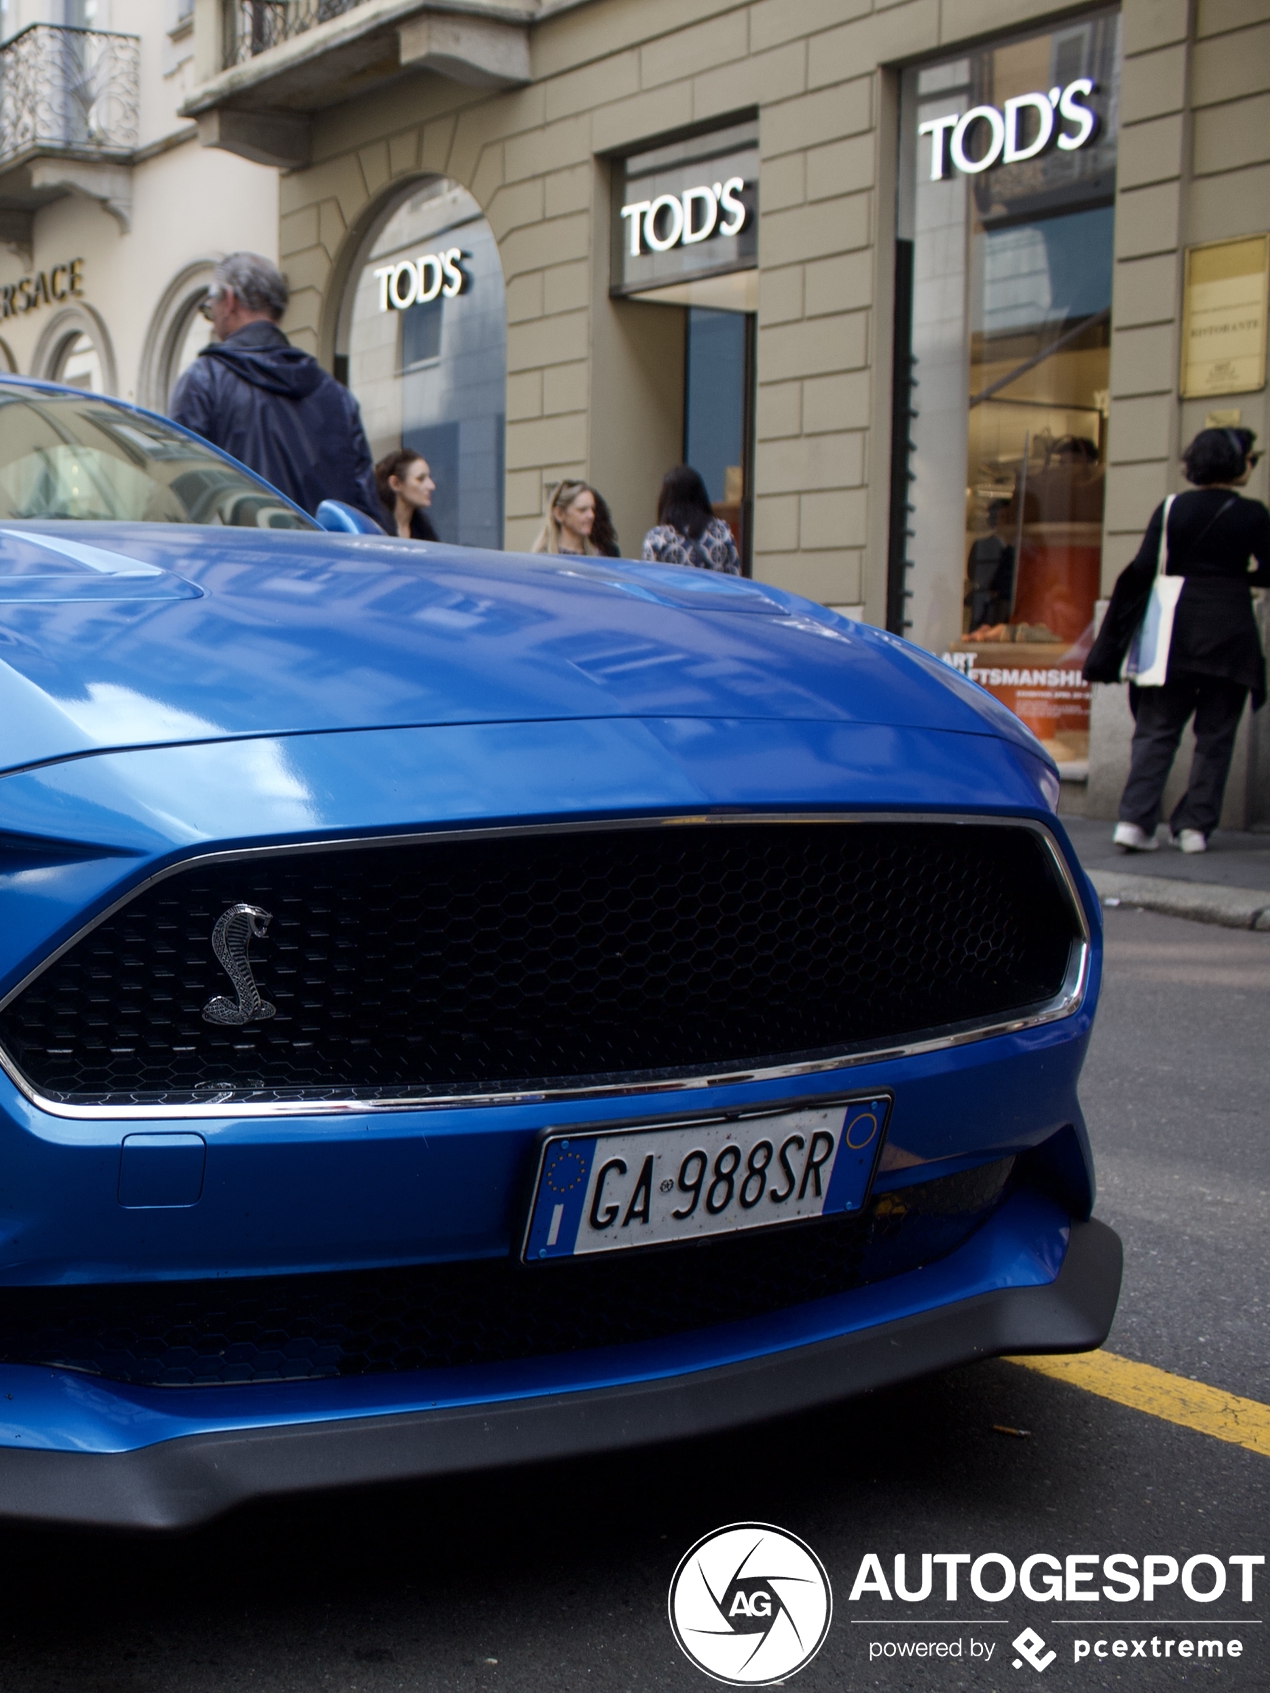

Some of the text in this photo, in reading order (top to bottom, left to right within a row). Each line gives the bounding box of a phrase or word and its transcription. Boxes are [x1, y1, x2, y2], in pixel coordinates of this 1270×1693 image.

[918, 77, 1096, 182] TOD'S
[620, 176, 746, 257] TOD'S
[373, 247, 463, 313] TOD'S
[960, 668, 1088, 687] FTSMANSHI
